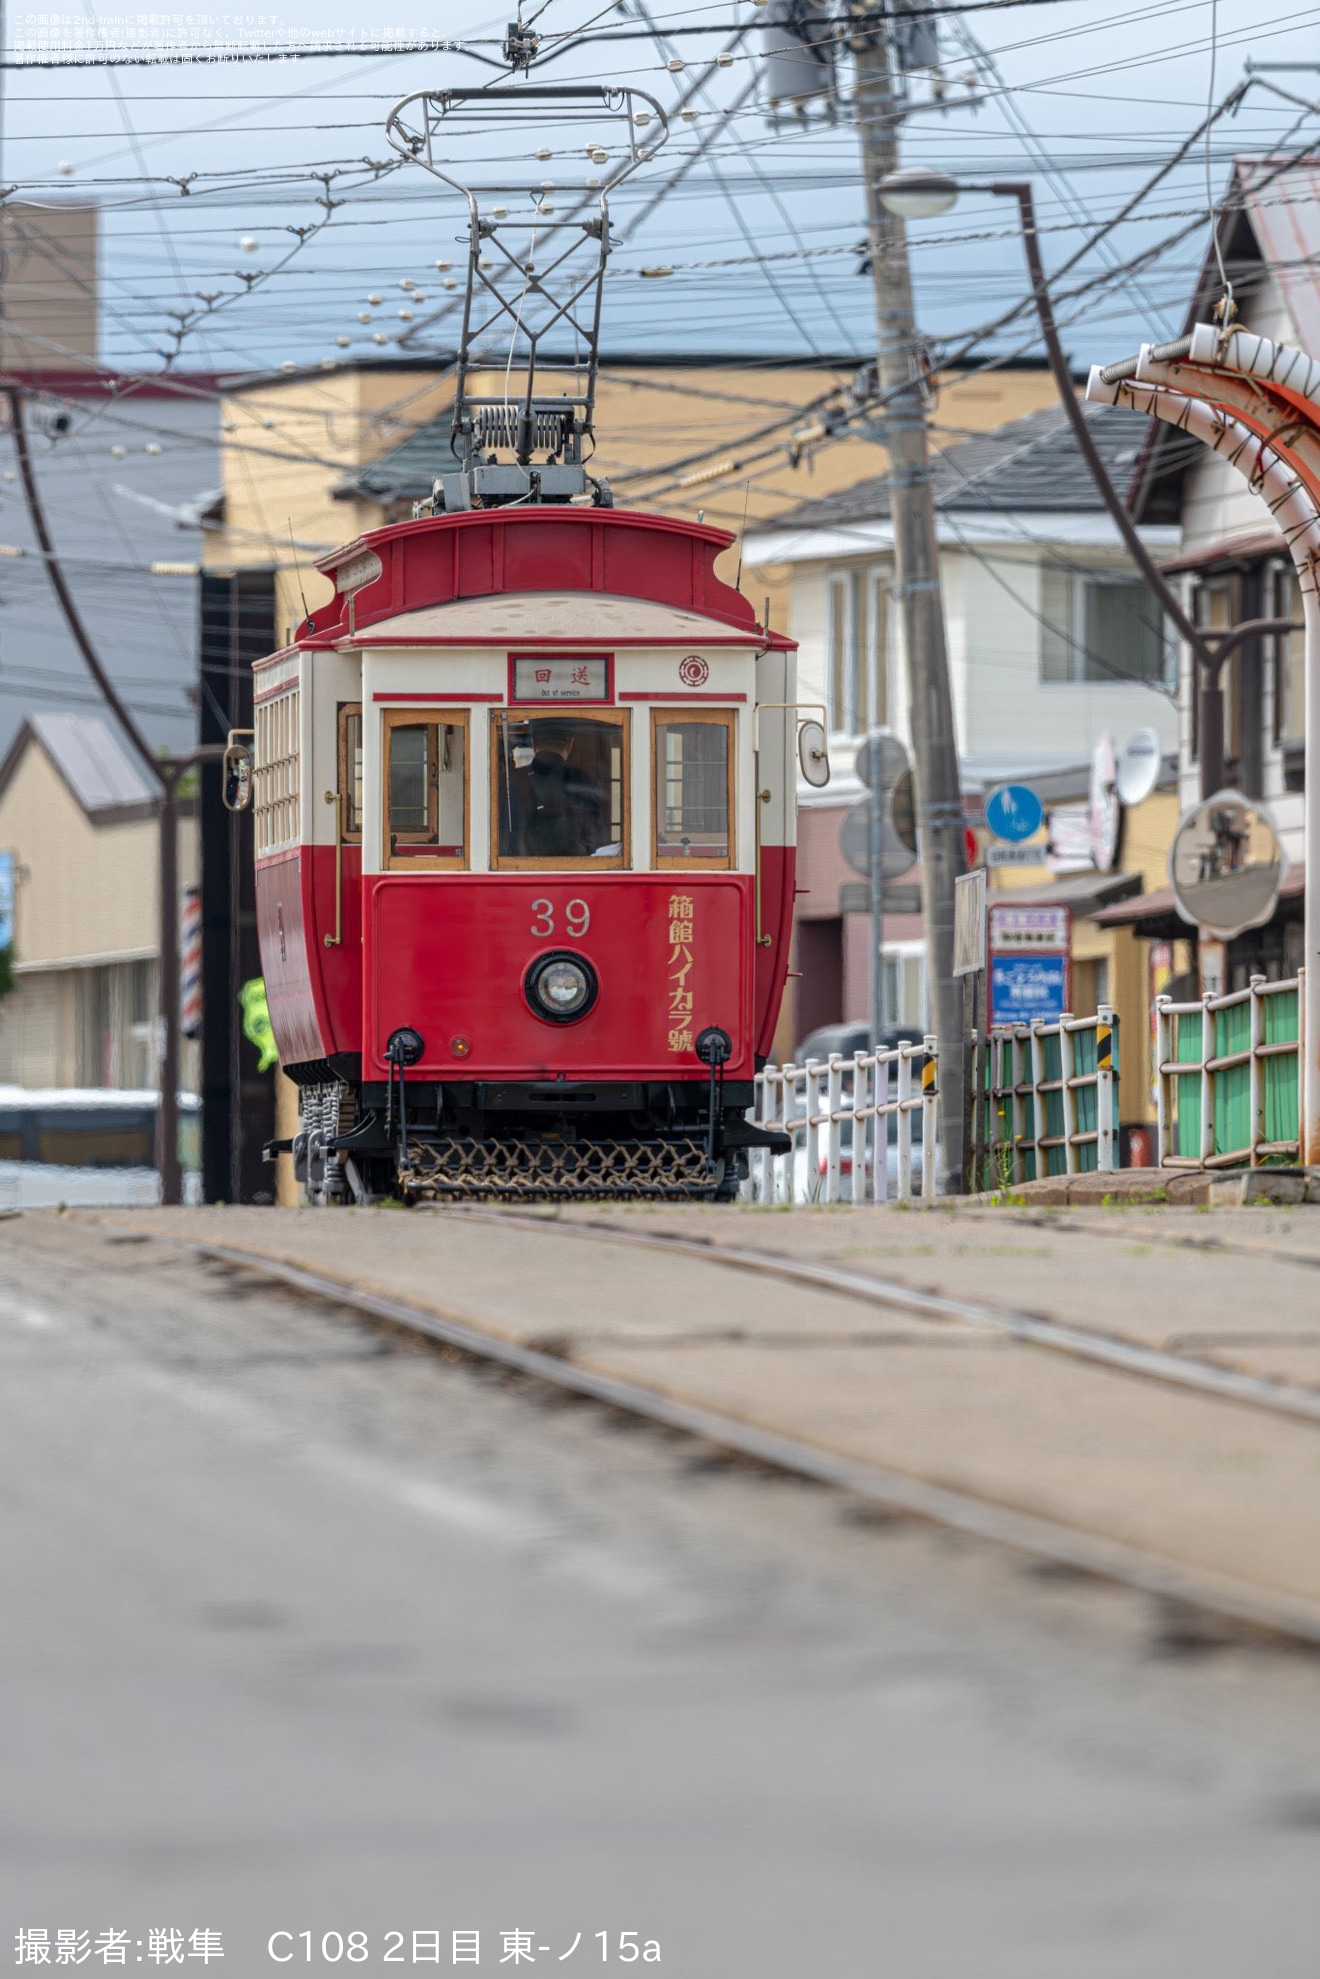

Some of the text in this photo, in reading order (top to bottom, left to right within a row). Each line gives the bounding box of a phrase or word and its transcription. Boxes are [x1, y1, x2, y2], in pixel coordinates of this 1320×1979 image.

[534, 666, 591, 686] 回送
[541, 689, 551, 697] Out
[530, 898, 591, 938] 39
[667, 894, 694, 1052] 箱館ハイカラ號
